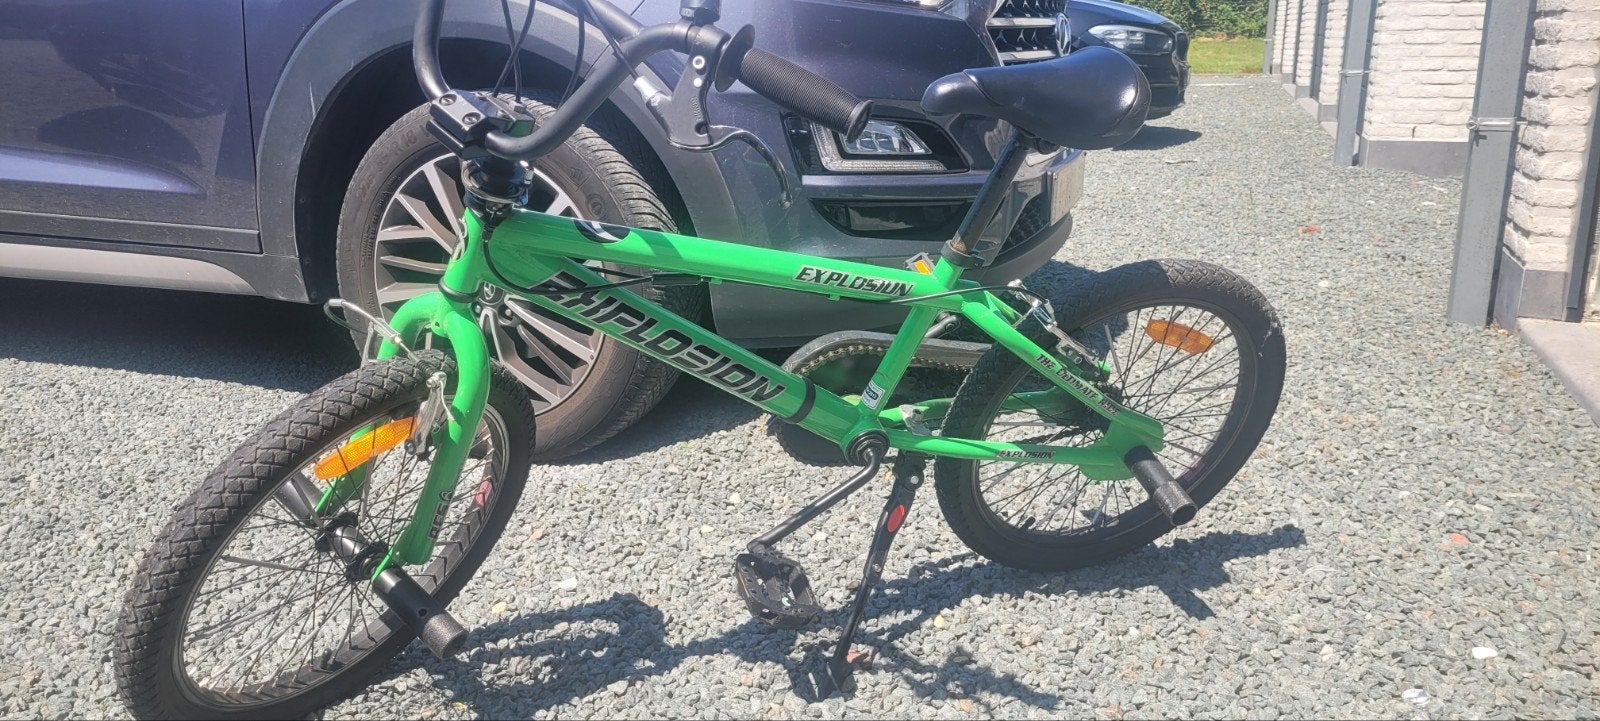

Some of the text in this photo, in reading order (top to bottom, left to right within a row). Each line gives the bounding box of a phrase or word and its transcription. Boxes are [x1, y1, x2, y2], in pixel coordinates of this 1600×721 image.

[795, 266, 914, 297] EXPLOSION
[1036, 353, 1057, 370] THE
[998, 450, 1055, 459] EXPLOSION
